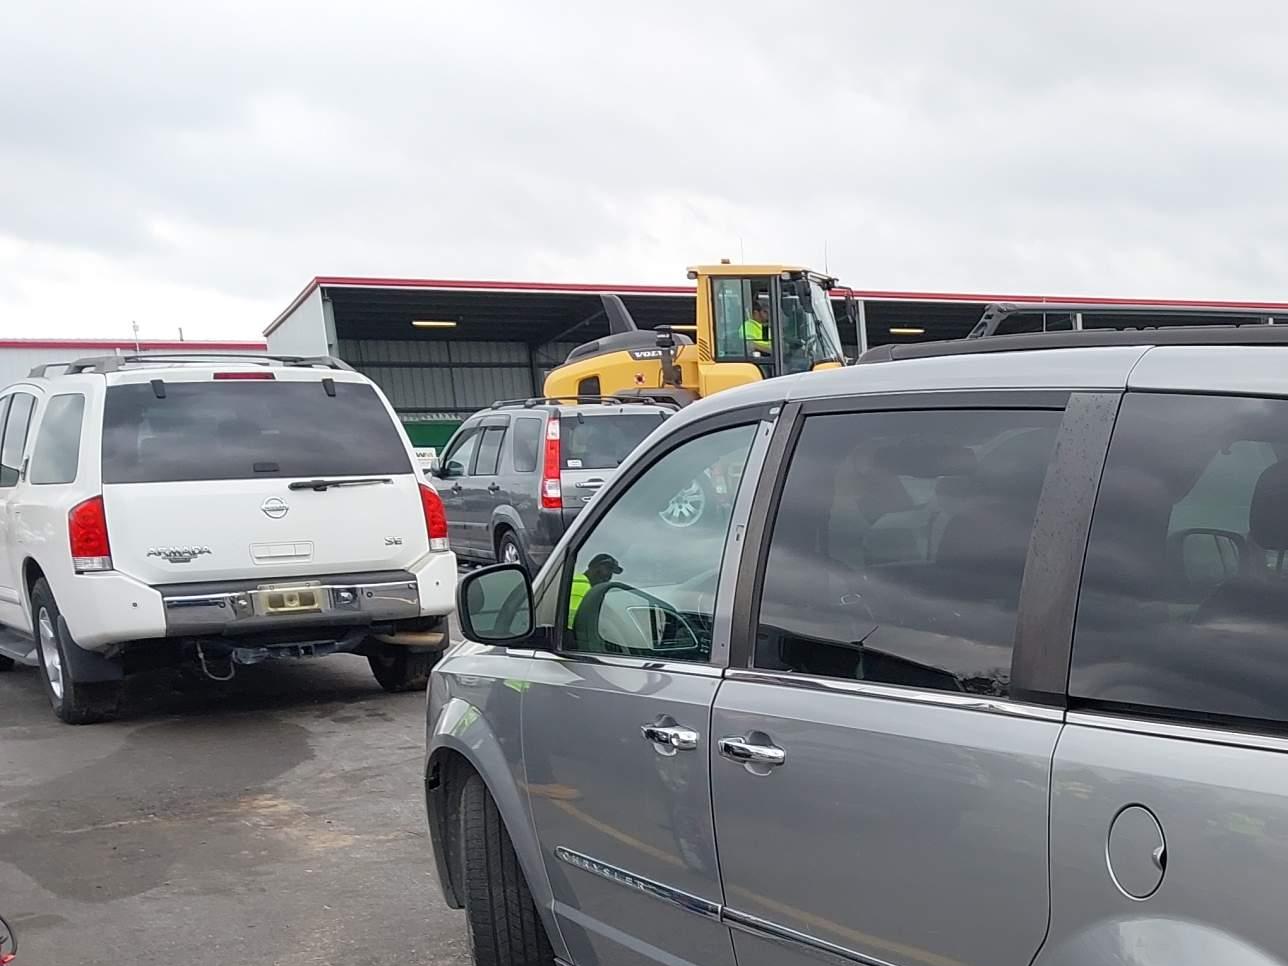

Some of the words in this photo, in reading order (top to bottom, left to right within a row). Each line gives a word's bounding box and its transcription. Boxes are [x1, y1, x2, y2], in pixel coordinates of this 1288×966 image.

[384, 536, 403, 546] SE
[146, 545, 213, 558] ARMADA
[561, 850, 646, 892] CHRYSLER
